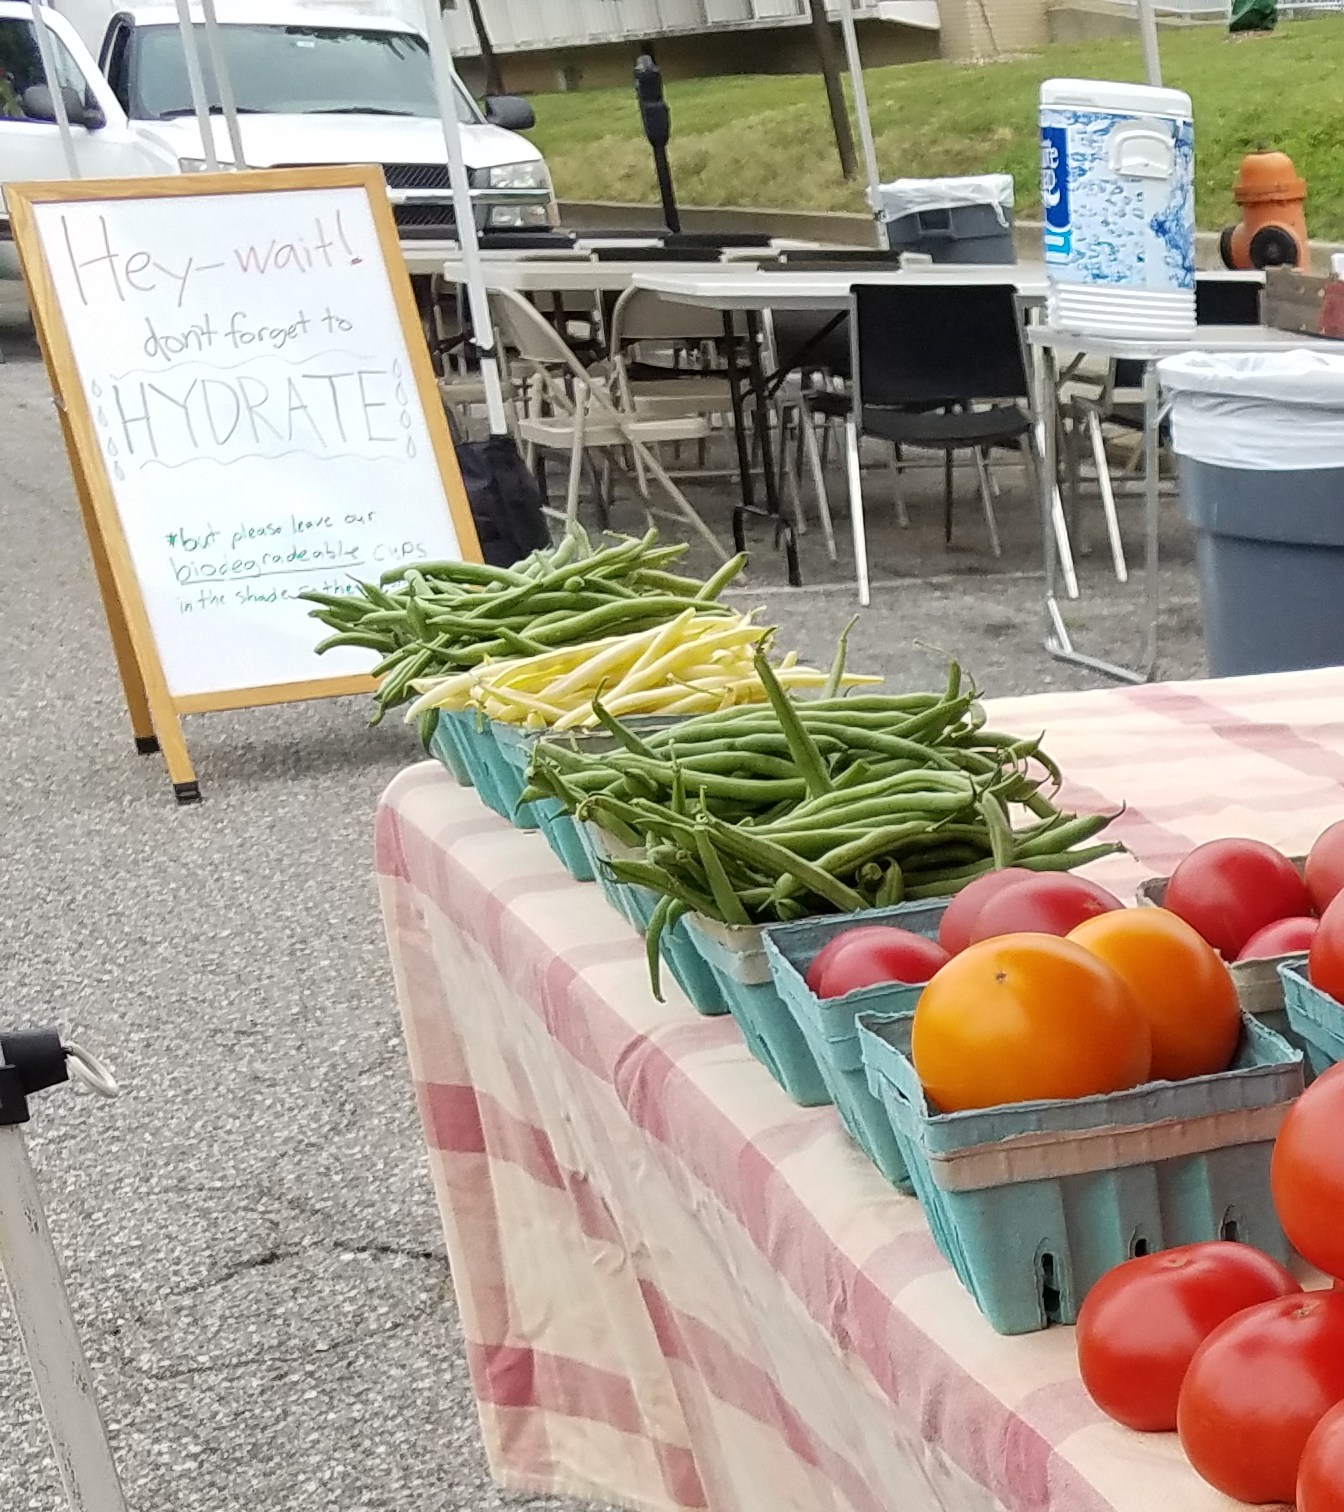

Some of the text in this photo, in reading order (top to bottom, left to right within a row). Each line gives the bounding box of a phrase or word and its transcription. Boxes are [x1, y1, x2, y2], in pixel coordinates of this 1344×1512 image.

[223, 310, 311, 349] forget
[321, 306, 353, 334] to
[112, 370, 397, 458] HYDRATE
[232, 522, 282, 550] please
[290, 513, 334, 534] leave
[344, 511, 376, 524] our
[168, 540, 360, 584] biodegradeable
[177, 597, 193, 614] in
[198, 589, 226, 609] the
